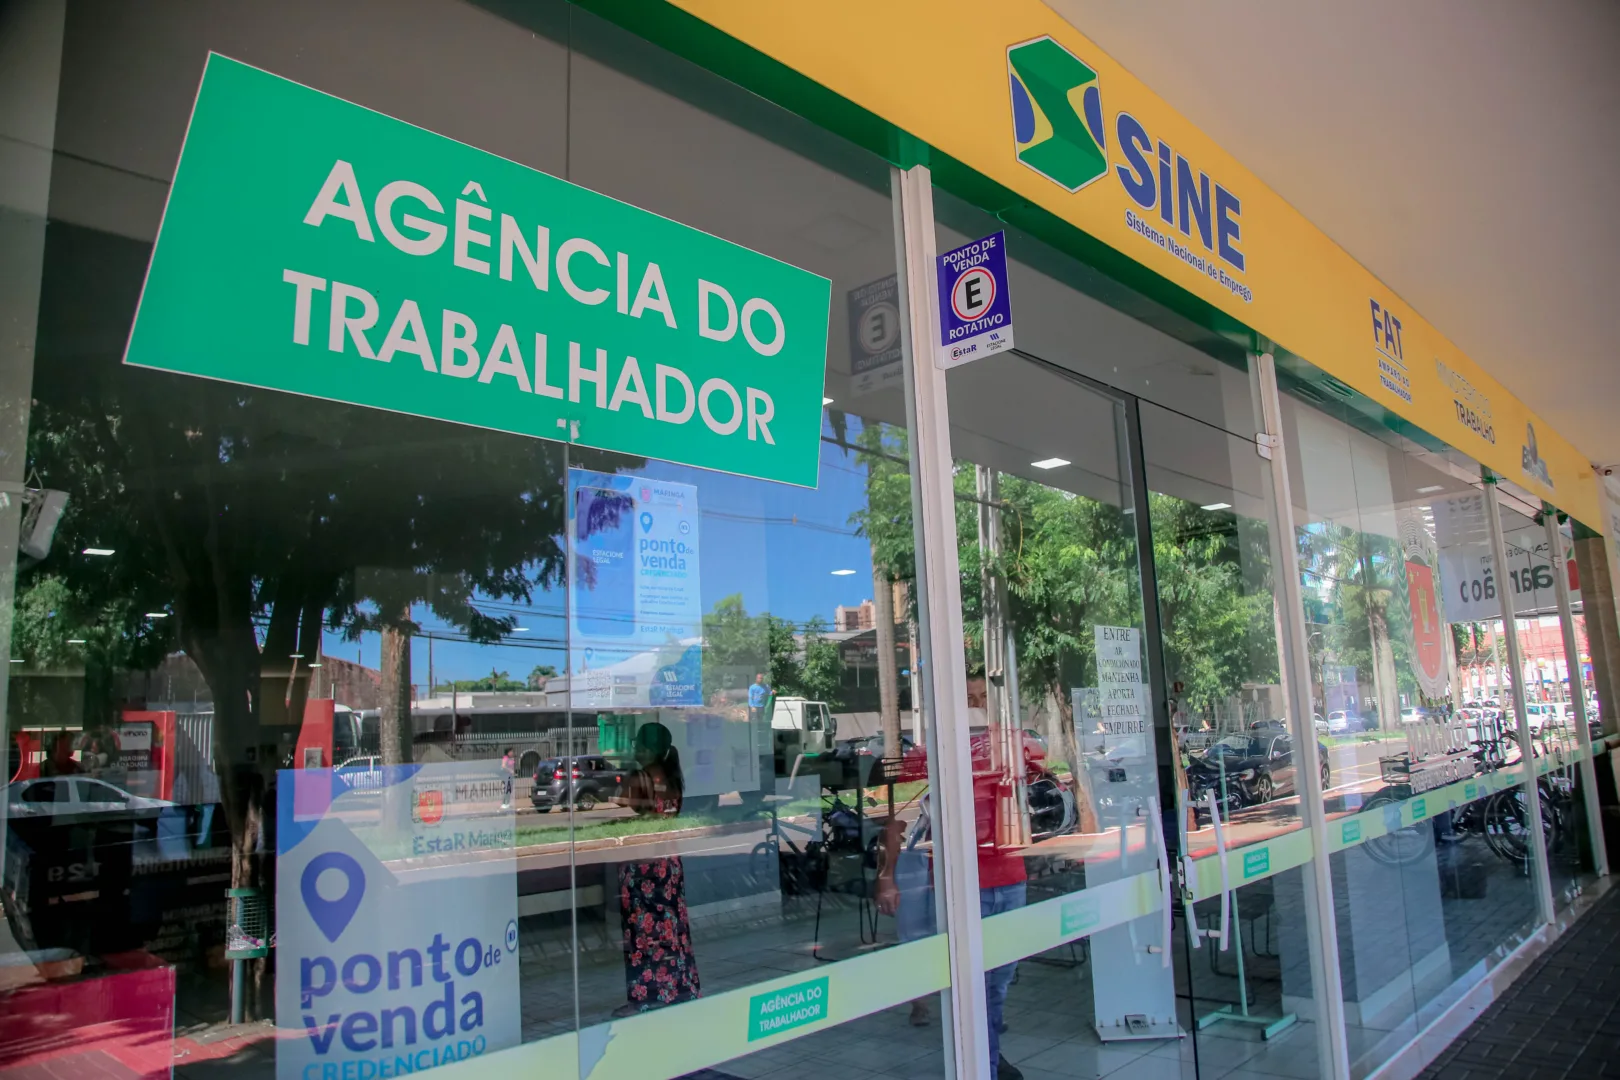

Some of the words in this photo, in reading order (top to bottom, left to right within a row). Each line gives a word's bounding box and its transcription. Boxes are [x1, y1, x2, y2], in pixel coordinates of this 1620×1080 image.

[303, 159, 678, 330] AGÊNCIA
[698, 279, 785, 357] DO
[943, 244, 979, 266] PONTO
[982, 237, 996, 251] DE
[953, 251, 990, 273] VENDA
[1126, 209, 1165, 247] Sistema
[1168, 236, 1206, 273] Nacional
[1207, 260, 1218, 279] de
[1219, 270, 1252, 302] Emprego
[965, 277, 982, 310] E
[949, 313, 1004, 340] ROTATIVO
[1370, 298, 1402, 360] FAT
[283, 269, 776, 445] TRABALHADOR
[951, 344, 977, 360] EstaR
[1453, 399, 1496, 444] TRABALHO
[640, 539, 686, 554] ponto
[640, 554, 686, 570] venda
[1103, 627, 1131, 642] ENTRE
[1114, 646, 1123, 656] AR
[1101, 672, 1140, 683] MANTENHA
[1107, 704, 1140, 716] FECHADA
[1103, 721, 1145, 735] EMPURRE
[413, 832, 465, 855] EstaR
[301, 933, 483, 1009] ponto
[484, 944, 501, 968] de
[760, 992, 805, 1015] AGÊNCIA
[807, 986, 822, 1001] DO
[303, 981, 484, 1055] venda
[759, 1004, 821, 1032] TRABALHADOR
[303, 1035, 486, 1080] CREDENCIADO
